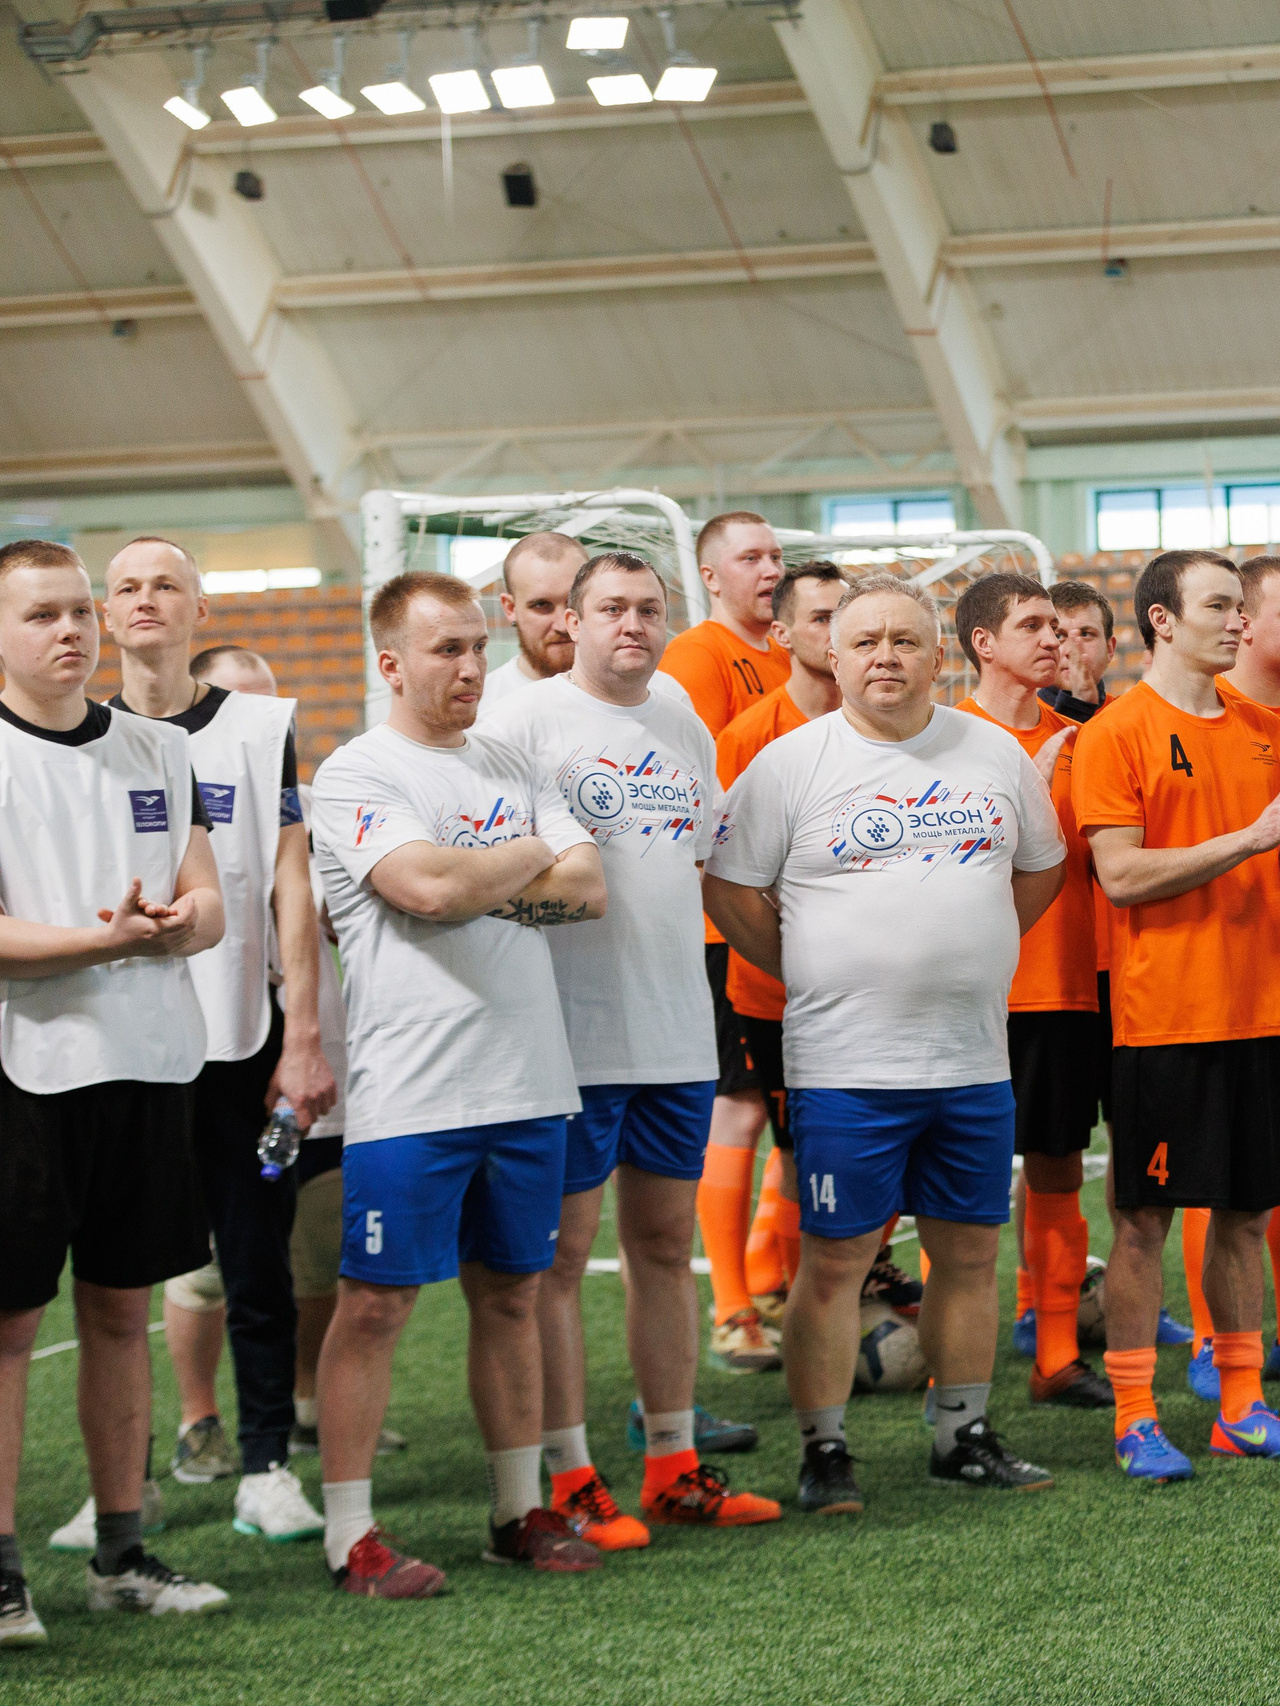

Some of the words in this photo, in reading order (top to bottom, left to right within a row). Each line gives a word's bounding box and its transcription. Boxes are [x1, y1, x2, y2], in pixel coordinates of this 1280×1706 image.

[733, 658, 764, 695] 10
[1170, 733, 1194, 777] 4
[626, 782, 689, 803] ЭСКОН
[631, 802, 656, 811] МОЩЬ
[657, 803, 690, 814] МЕТАЛЛА
[907, 809, 984, 829] ЭСКОН
[913, 831, 943, 839] МОЩЬ
[944, 827, 986, 838] МЕТАЛЛА
[1147, 1142, 1169, 1186] 4
[809, 1172, 837, 1213] 14
[365, 1210, 383, 1255] 5
